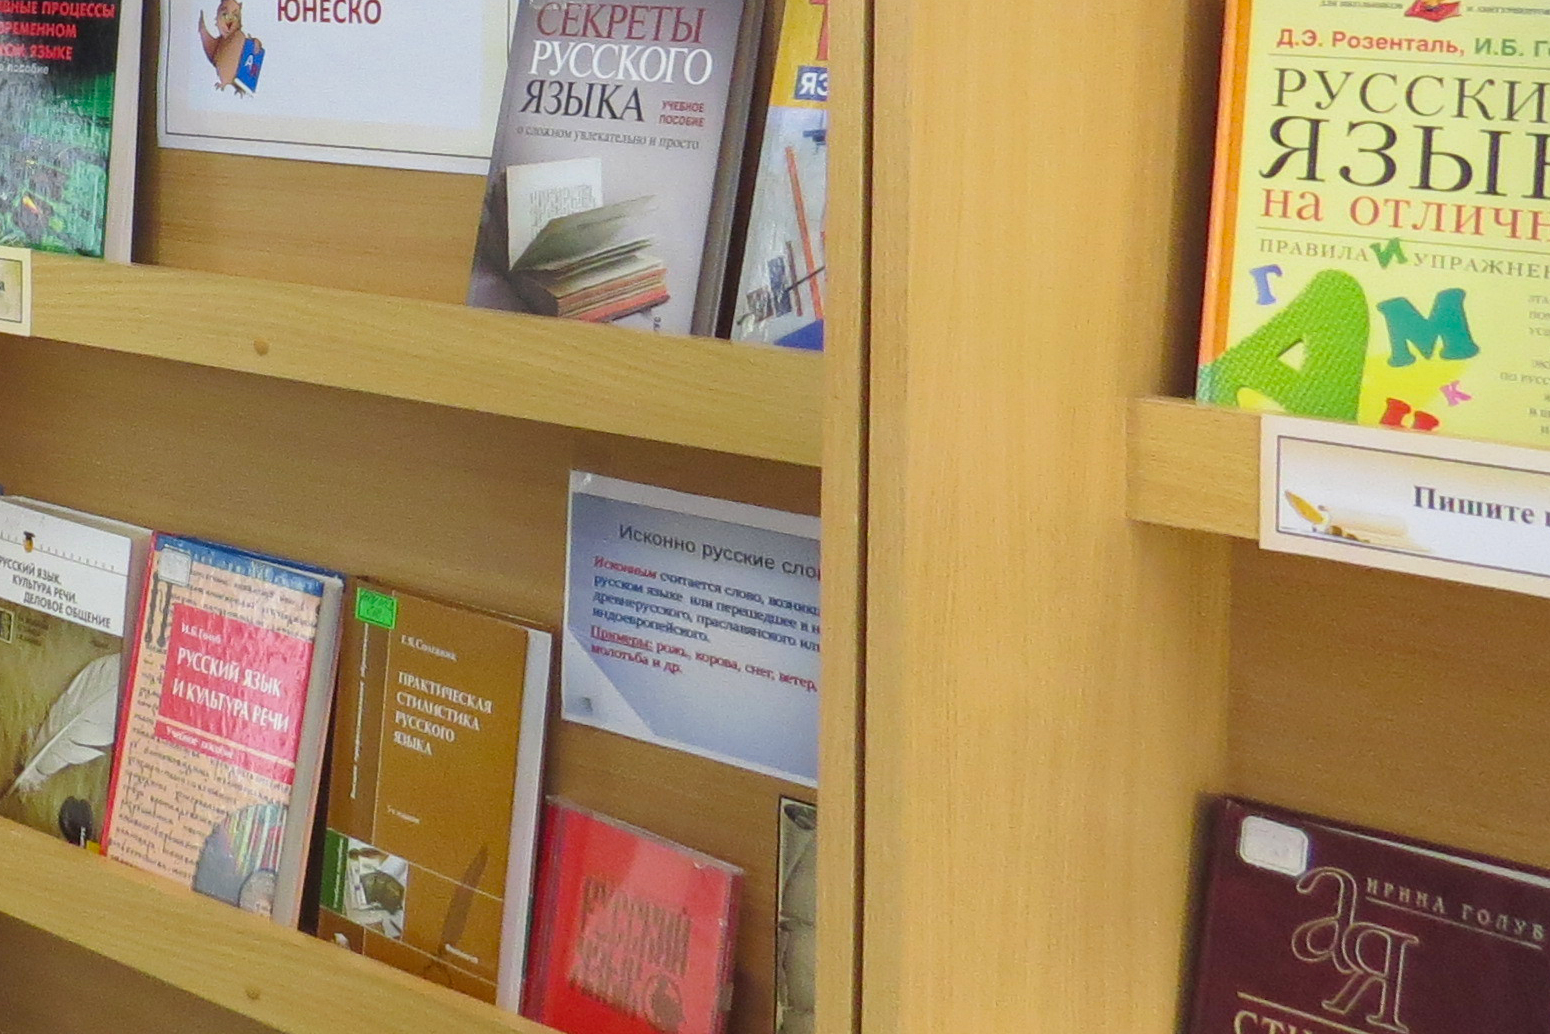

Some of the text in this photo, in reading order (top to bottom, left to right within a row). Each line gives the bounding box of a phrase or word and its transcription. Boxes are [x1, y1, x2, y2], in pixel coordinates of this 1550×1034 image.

[41, 1, 116, 18] ПРОЦЕССЫ
[536, 2, 706, 44] СЕКРЕТЫ
[30, 45, 73, 61] ЯЗЫКЕ
[1332, 31, 1465, 57] Розенталь,
[528, 40, 714, 85] РУССКОГО
[520, 79, 645, 123] ЯЗЫКА
[661, 99, 705, 113] УЧЕБНОЕ
[659, 113, 705, 128] ПОСОБИЕ
[1260, 187, 1324, 223] на
[1259, 238, 1369, 263] ПРАВИЛА
[1413, 484, 1535, 525] Пишите
[619, 523, 821, 582] Исконно русские сло
[12, 574, 52, 596] КУЛЬТУРА
[593, 575, 644, 594] русском
[646, 586, 684, 603] языке
[23, 591, 111, 629] ДЕЛОВОЕ ОБЩЕНИЕ
[592, 591, 693, 623] древнерусского,
[177, 647, 282, 697] РУССКИЙ ЯЗЫК
[591, 644, 649, 666] молотьба
[172, 677, 290, 733] И КУЛЬТУРА РЕЧИ
[398, 671, 494, 715] ПРАКТИЧЕСКАЯ
[394, 710, 456, 743] РУССКОГО
[396, 691, 481, 732] СТИЛИСТИКА
[393, 730, 433, 756] ЯЗЫКА
[1366, 875, 1447, 917] ИРИНА
